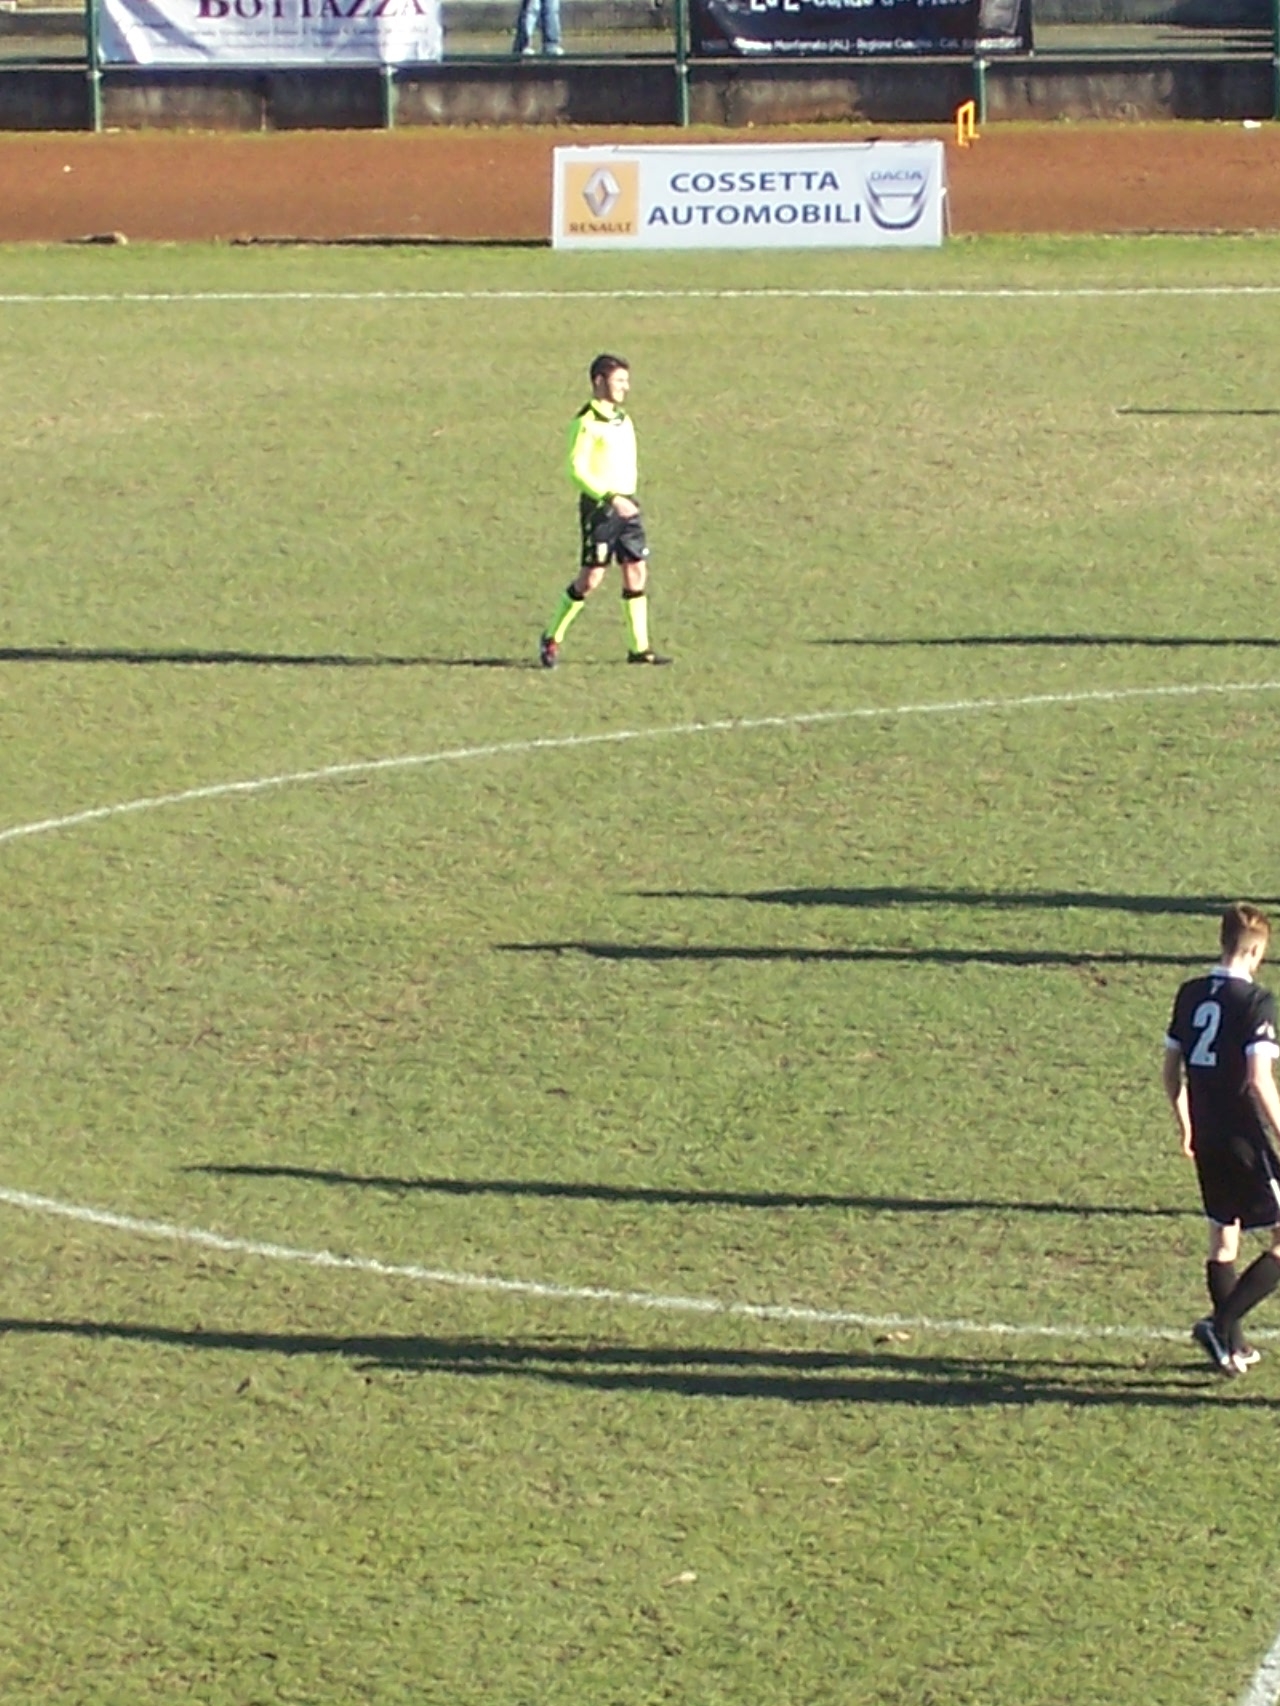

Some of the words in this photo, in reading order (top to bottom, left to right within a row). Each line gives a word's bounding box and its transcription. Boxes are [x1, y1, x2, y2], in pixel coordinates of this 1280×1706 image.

[670, 171, 839, 193] COSSETTA
[870, 170, 923, 182] DACIA
[647, 203, 861, 226] AUTOMOBILI
[569, 222, 632, 234] RENAULT
[1189, 1001, 1222, 1067] 2
